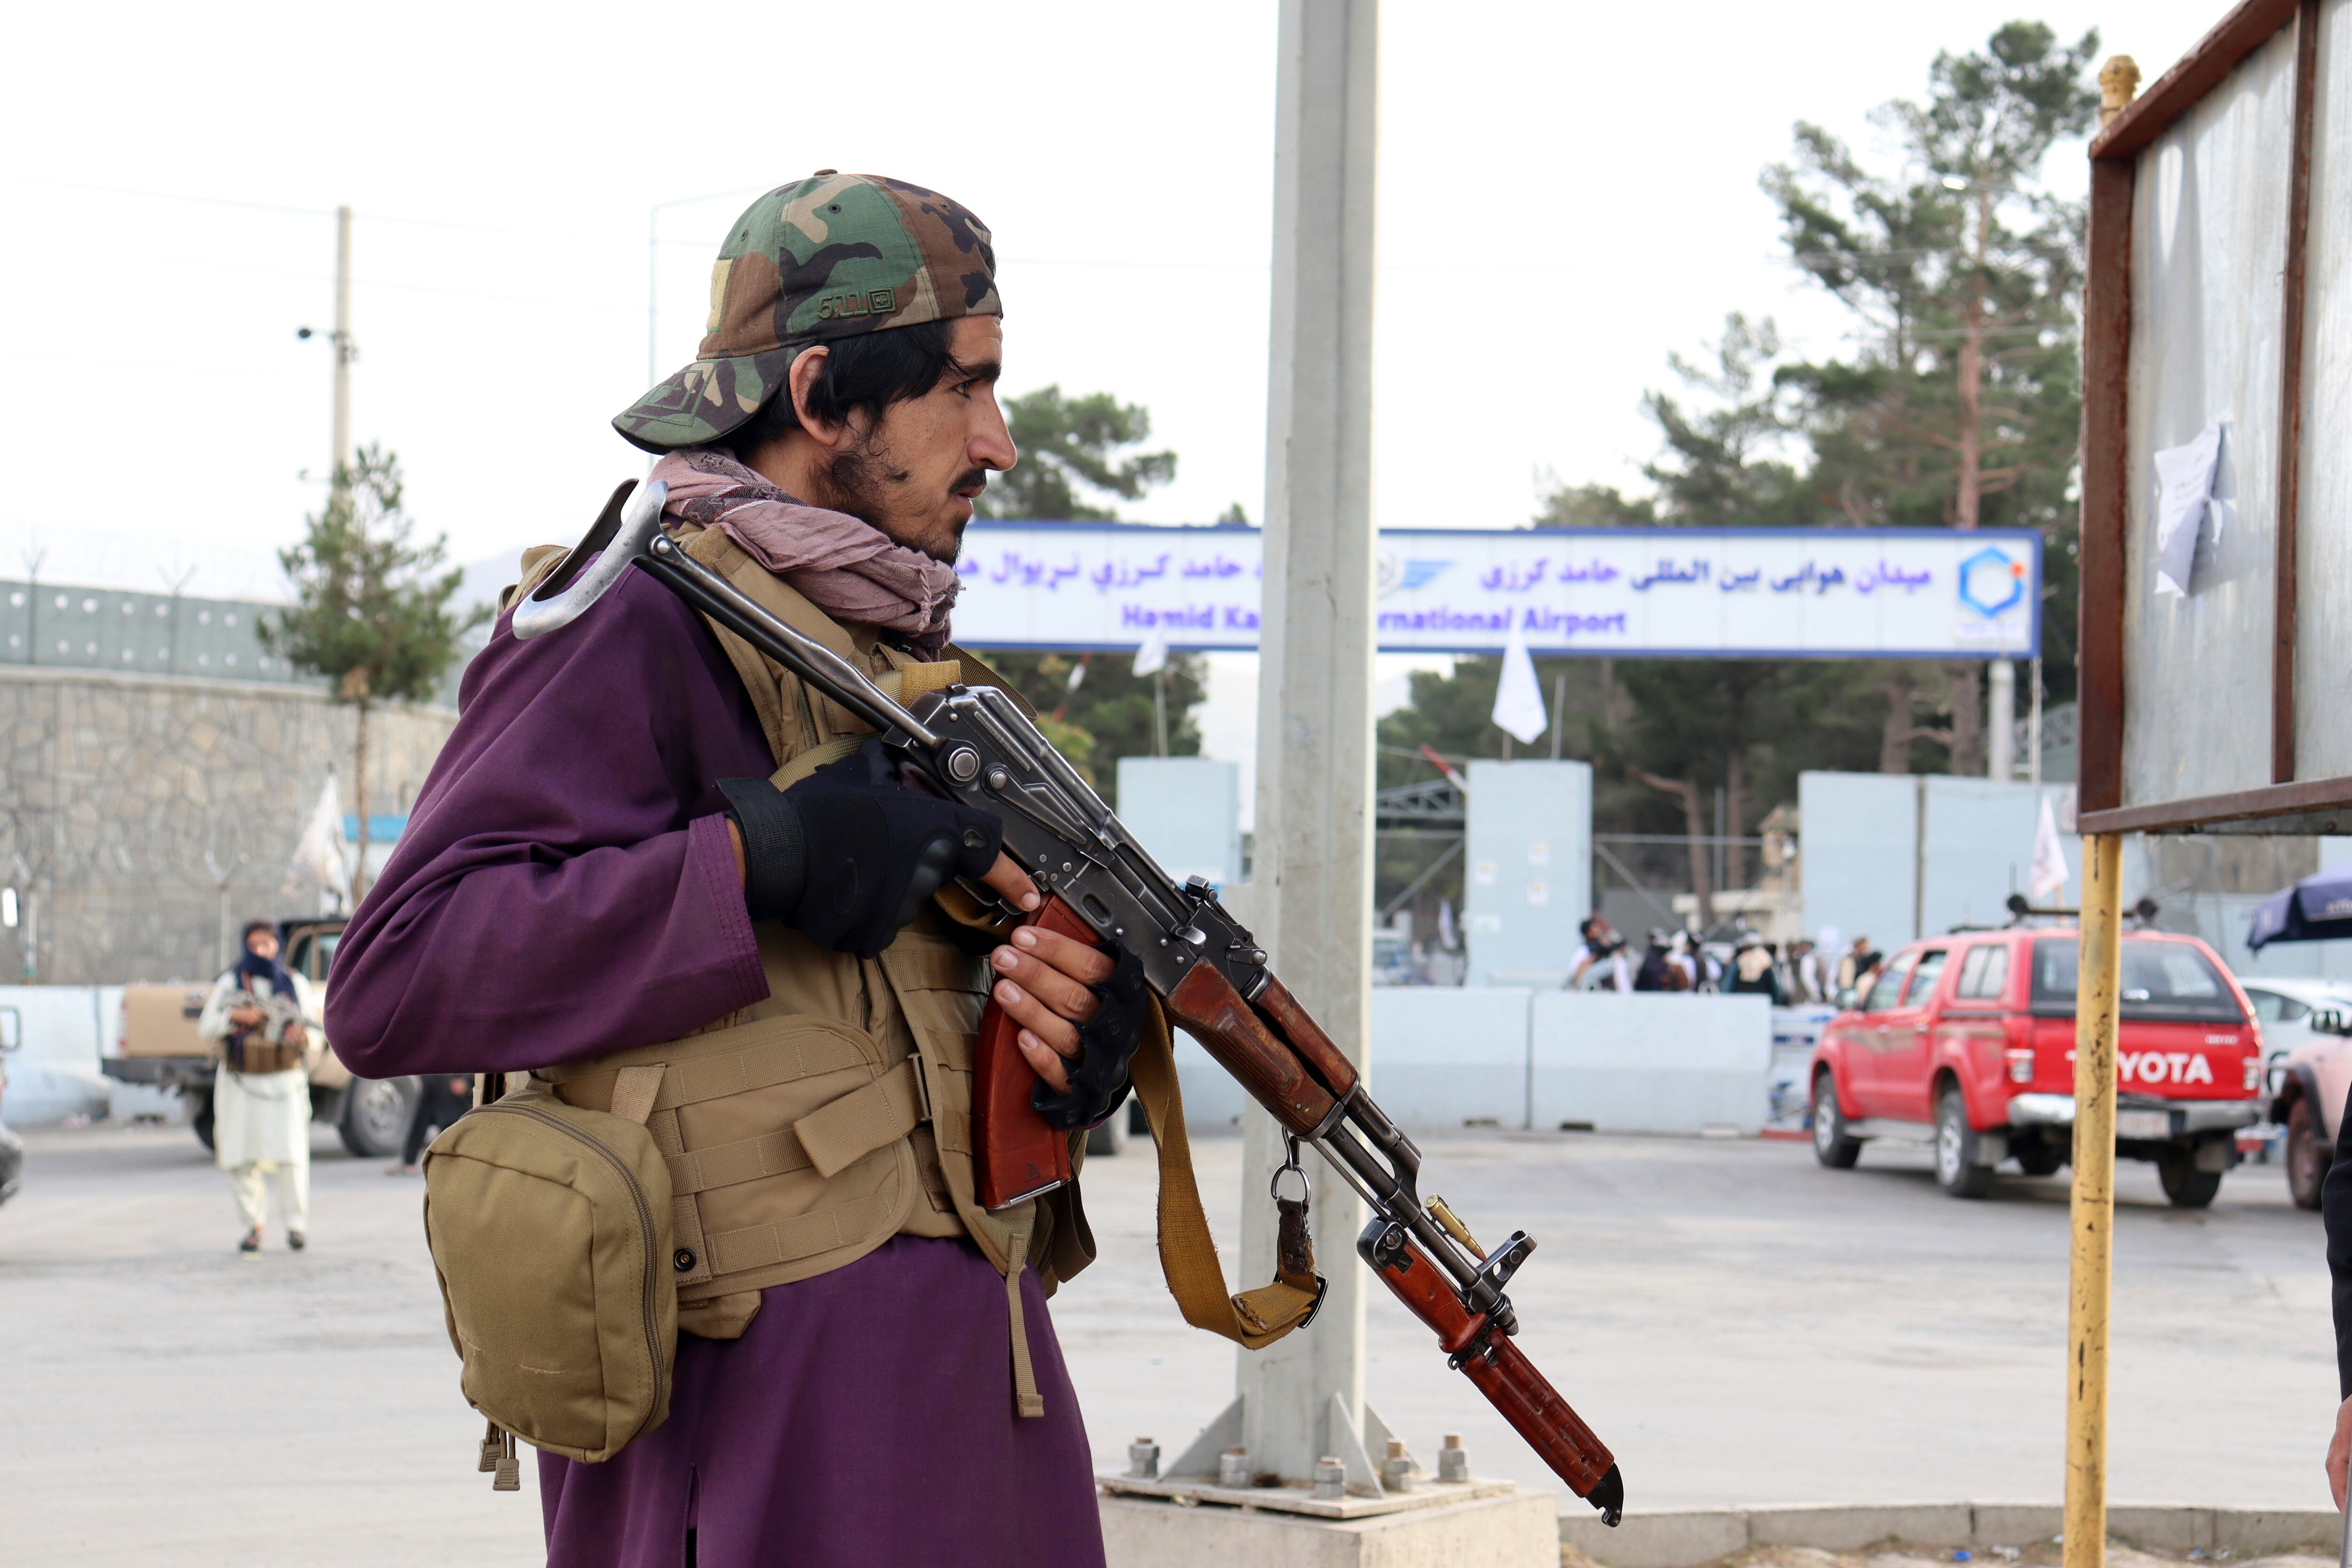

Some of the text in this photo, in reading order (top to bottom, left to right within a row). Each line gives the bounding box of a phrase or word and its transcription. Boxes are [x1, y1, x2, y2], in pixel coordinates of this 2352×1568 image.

[1182, 555, 1242, 579] حامد
[1558, 559, 1619, 583] حامد
[1855, 560, 1931, 594] میدان
[1123, 605, 1214, 629] Hamid
[1378, 606, 1511, 631] rnational
[1523, 608, 1625, 636] Airport
[2065, 1051, 2214, 1085] YOTA
